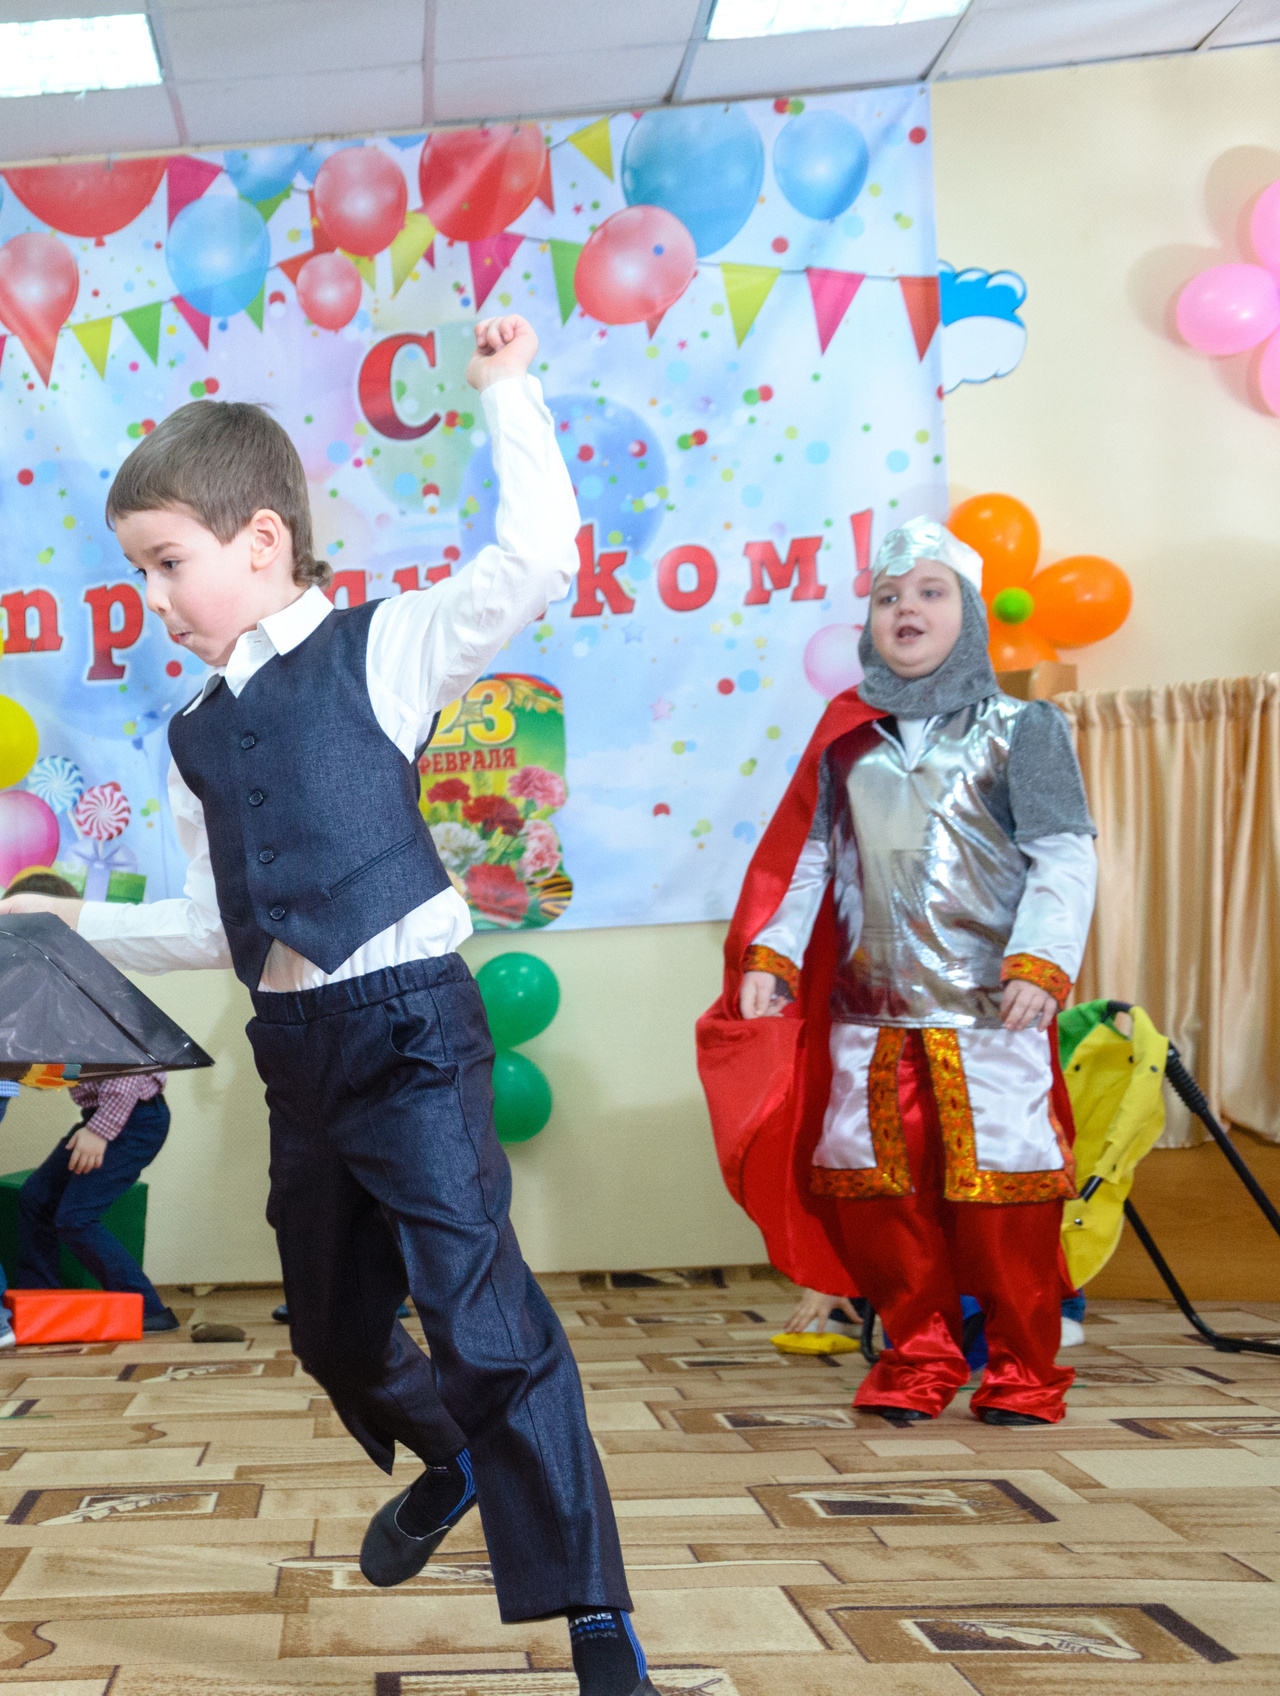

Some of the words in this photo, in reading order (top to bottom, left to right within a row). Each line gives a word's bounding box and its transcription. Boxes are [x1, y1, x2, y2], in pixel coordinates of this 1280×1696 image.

[358, 331, 442, 441] С
[0, 508, 873, 680] прком!
[428, 679, 517, 746] 23
[417, 747, 517, 775] ФЕВРАЛЯ
